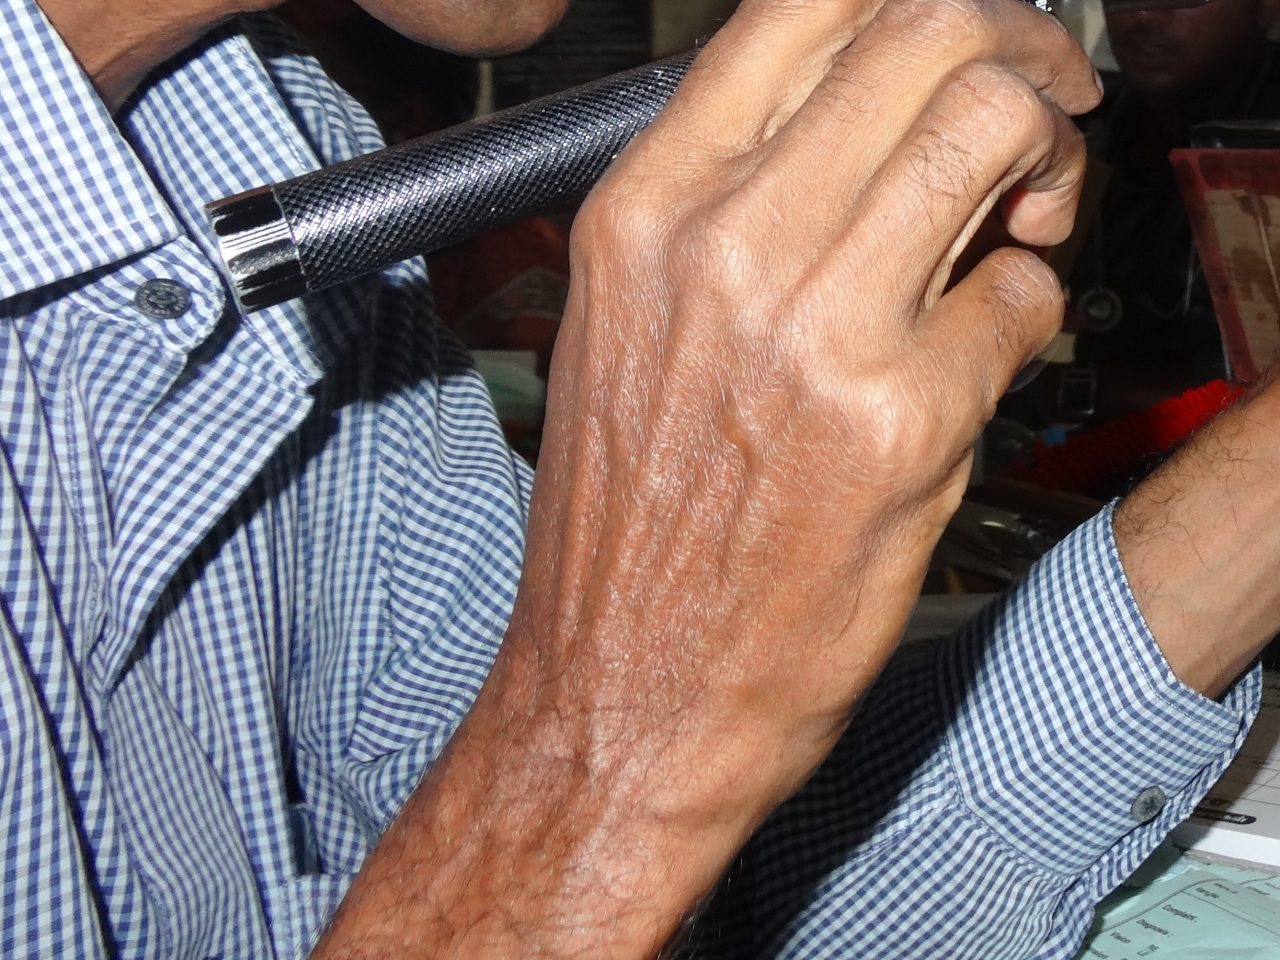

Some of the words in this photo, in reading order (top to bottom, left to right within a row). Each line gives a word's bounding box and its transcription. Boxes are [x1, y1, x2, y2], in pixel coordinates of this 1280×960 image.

[1162, 904, 1198, 921] Complaint
[1136, 919, 1169, 936] Diagnosis
[1110, 931, 1132, 944] Vision
